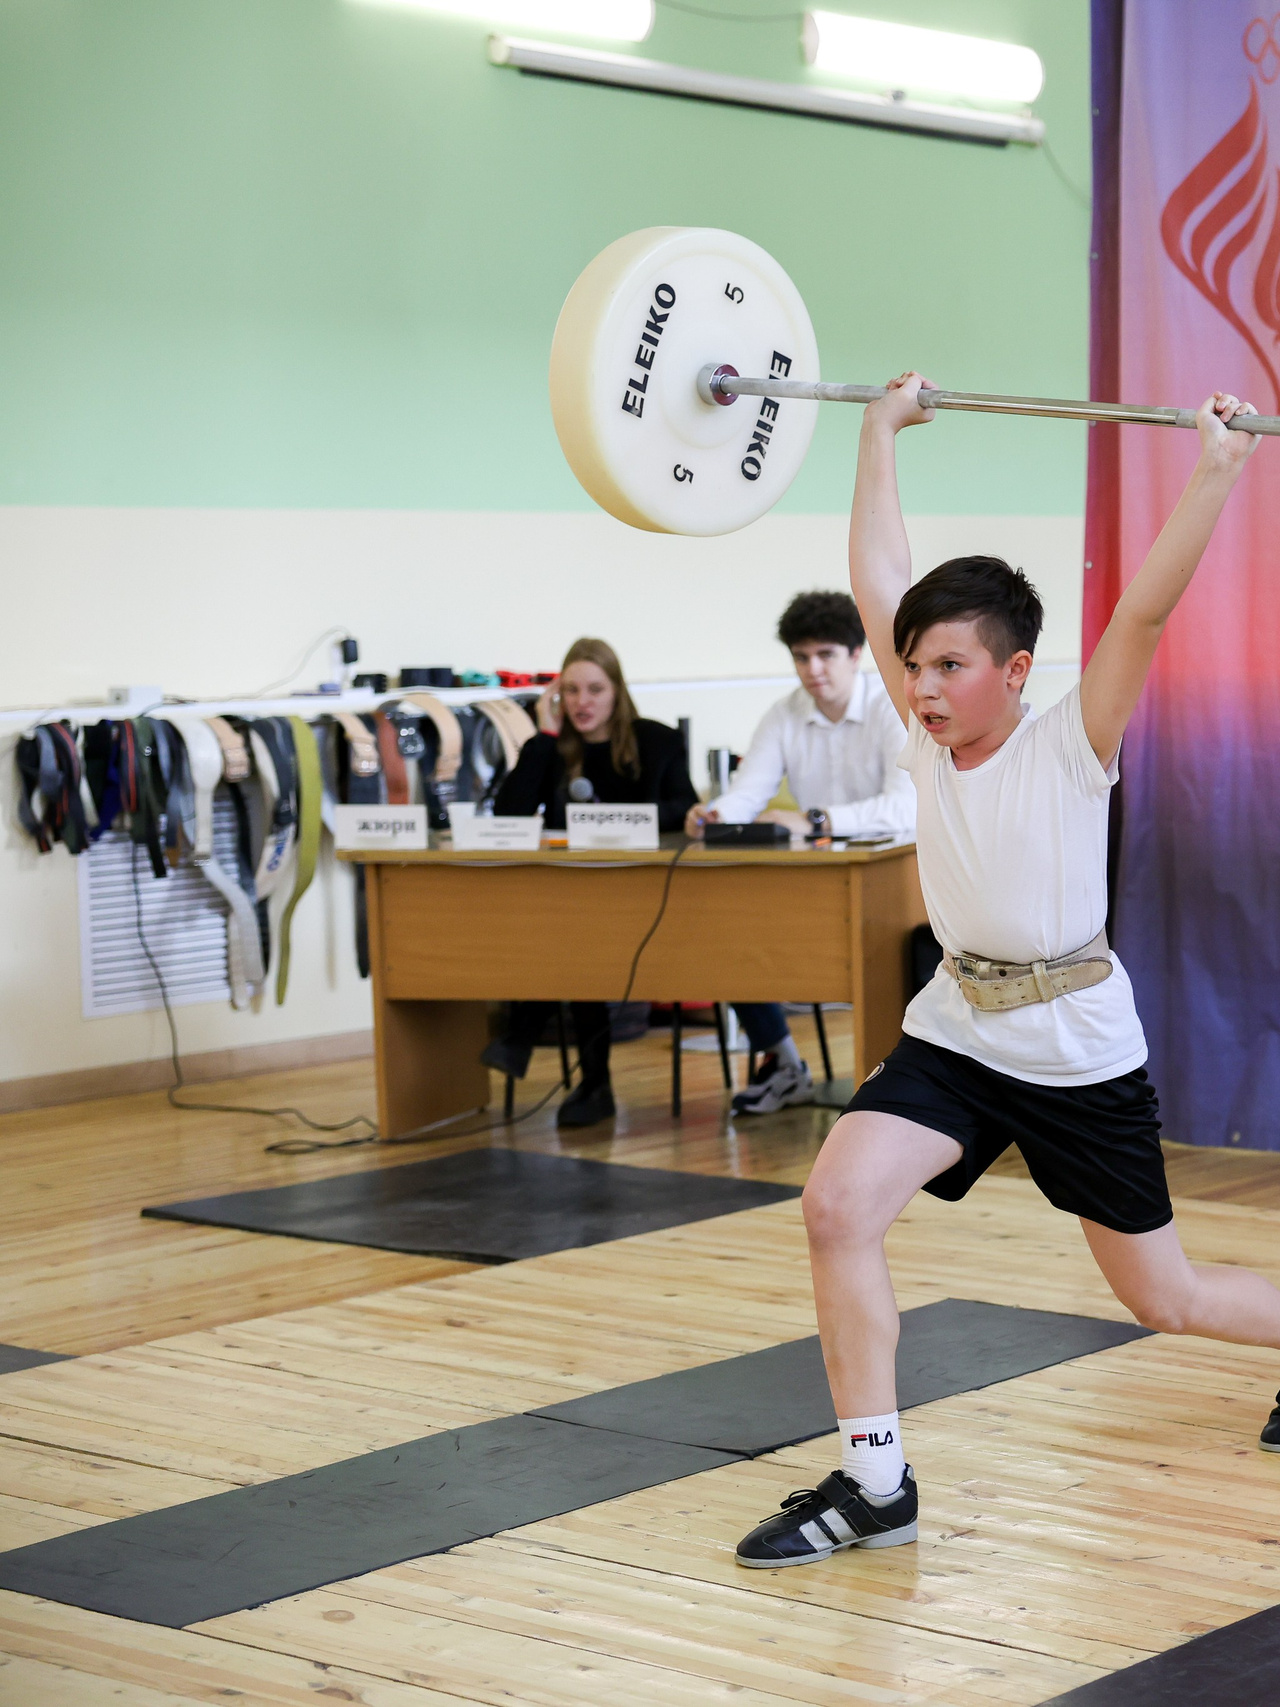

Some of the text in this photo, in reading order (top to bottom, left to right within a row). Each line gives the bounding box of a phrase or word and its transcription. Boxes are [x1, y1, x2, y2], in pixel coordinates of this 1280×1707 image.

[725, 282, 744, 304] 5
[621, 283, 677, 418] ELEIKO
[740, 350, 793, 481] EEIKO
[673, 463, 694, 484] 5
[571, 811, 651, 825] секретарь
[357, 820, 417, 838] жюри
[850, 1430, 894, 1448] FILA
